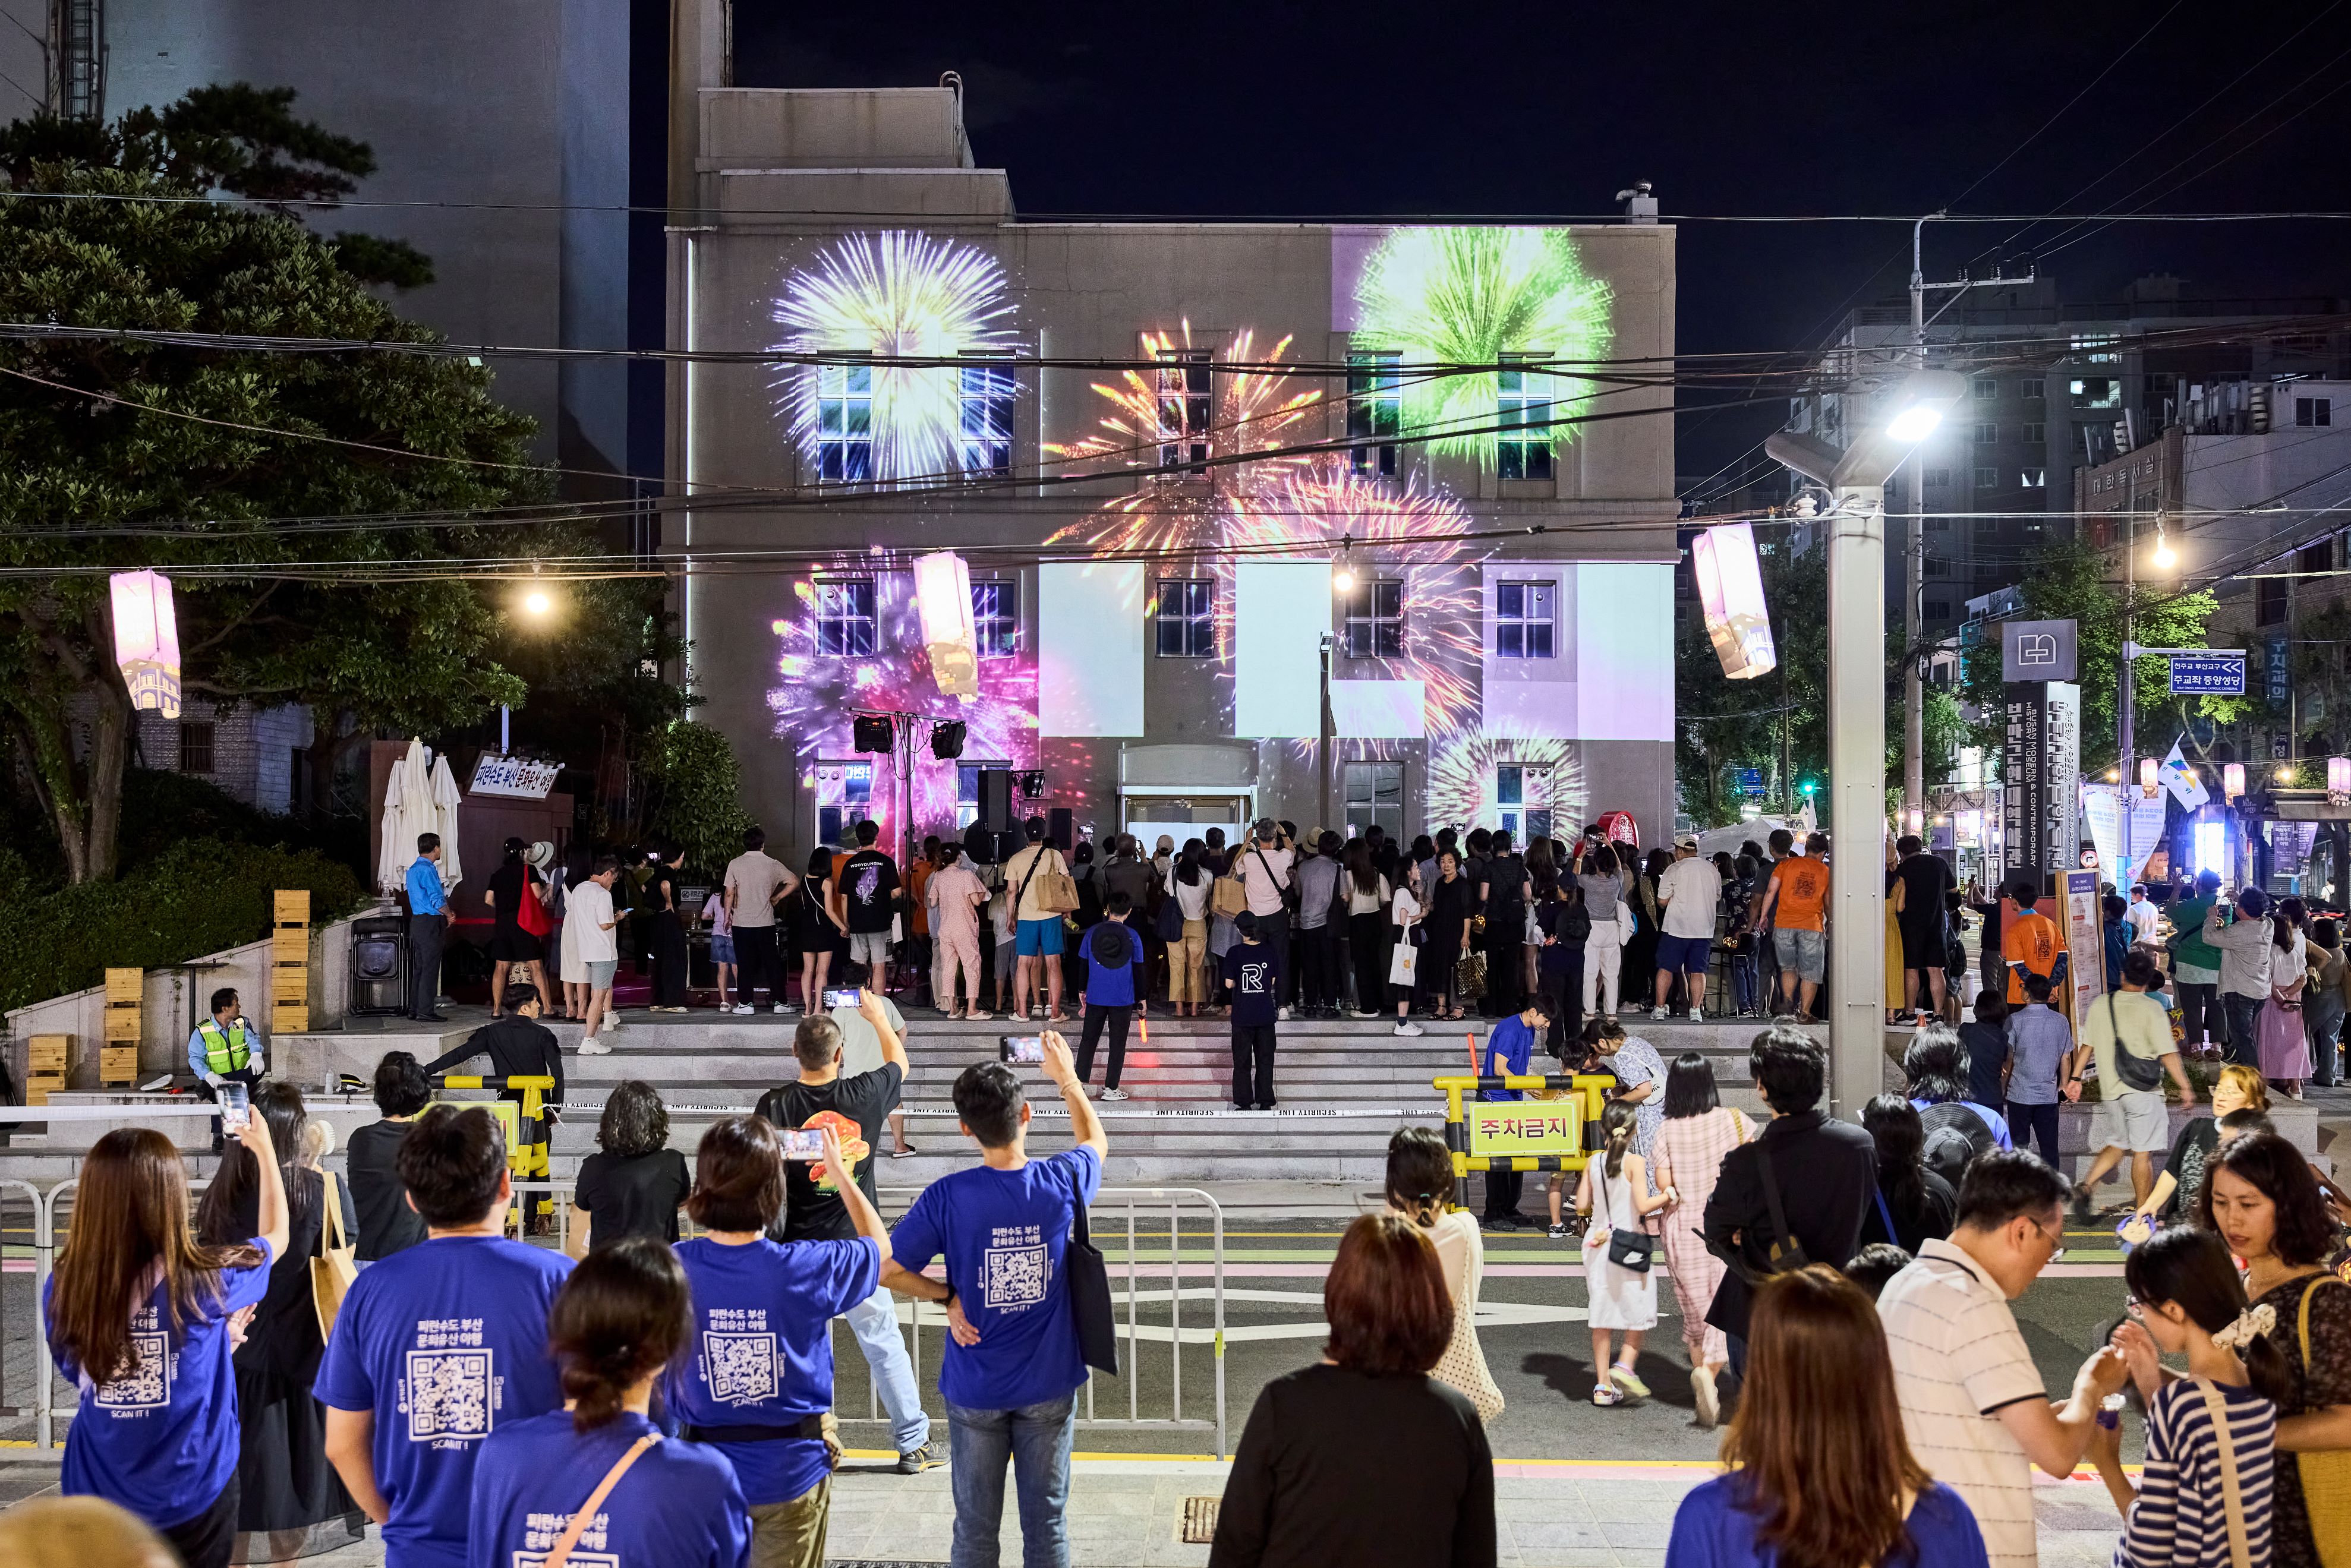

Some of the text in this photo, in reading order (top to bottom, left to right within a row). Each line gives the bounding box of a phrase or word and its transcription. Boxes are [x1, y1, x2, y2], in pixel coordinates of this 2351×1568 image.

[2094, 454, 2154, 496] 대한독서실
[2174, 675, 2240, 686] 주교좌 중앙성당
[475, 764, 555, 793] 피란수도 부산 문화유산 야행
[1481, 1118, 1567, 1139] 주차금지
[992, 1225, 1040, 1237] 피란수도 부산
[992, 1235, 1041, 1247] 문화유산 야행
[709, 1309, 767, 1320] 피란수도 부산
[138, 1318, 158, 1329] 야행
[417, 1318, 483, 1333] 피란수도 부산
[710, 1320, 767, 1331] 문화유산 야행
[417, 1332, 483, 1348] 문화유산 야행
[579, 1531, 607, 1551] 야행
